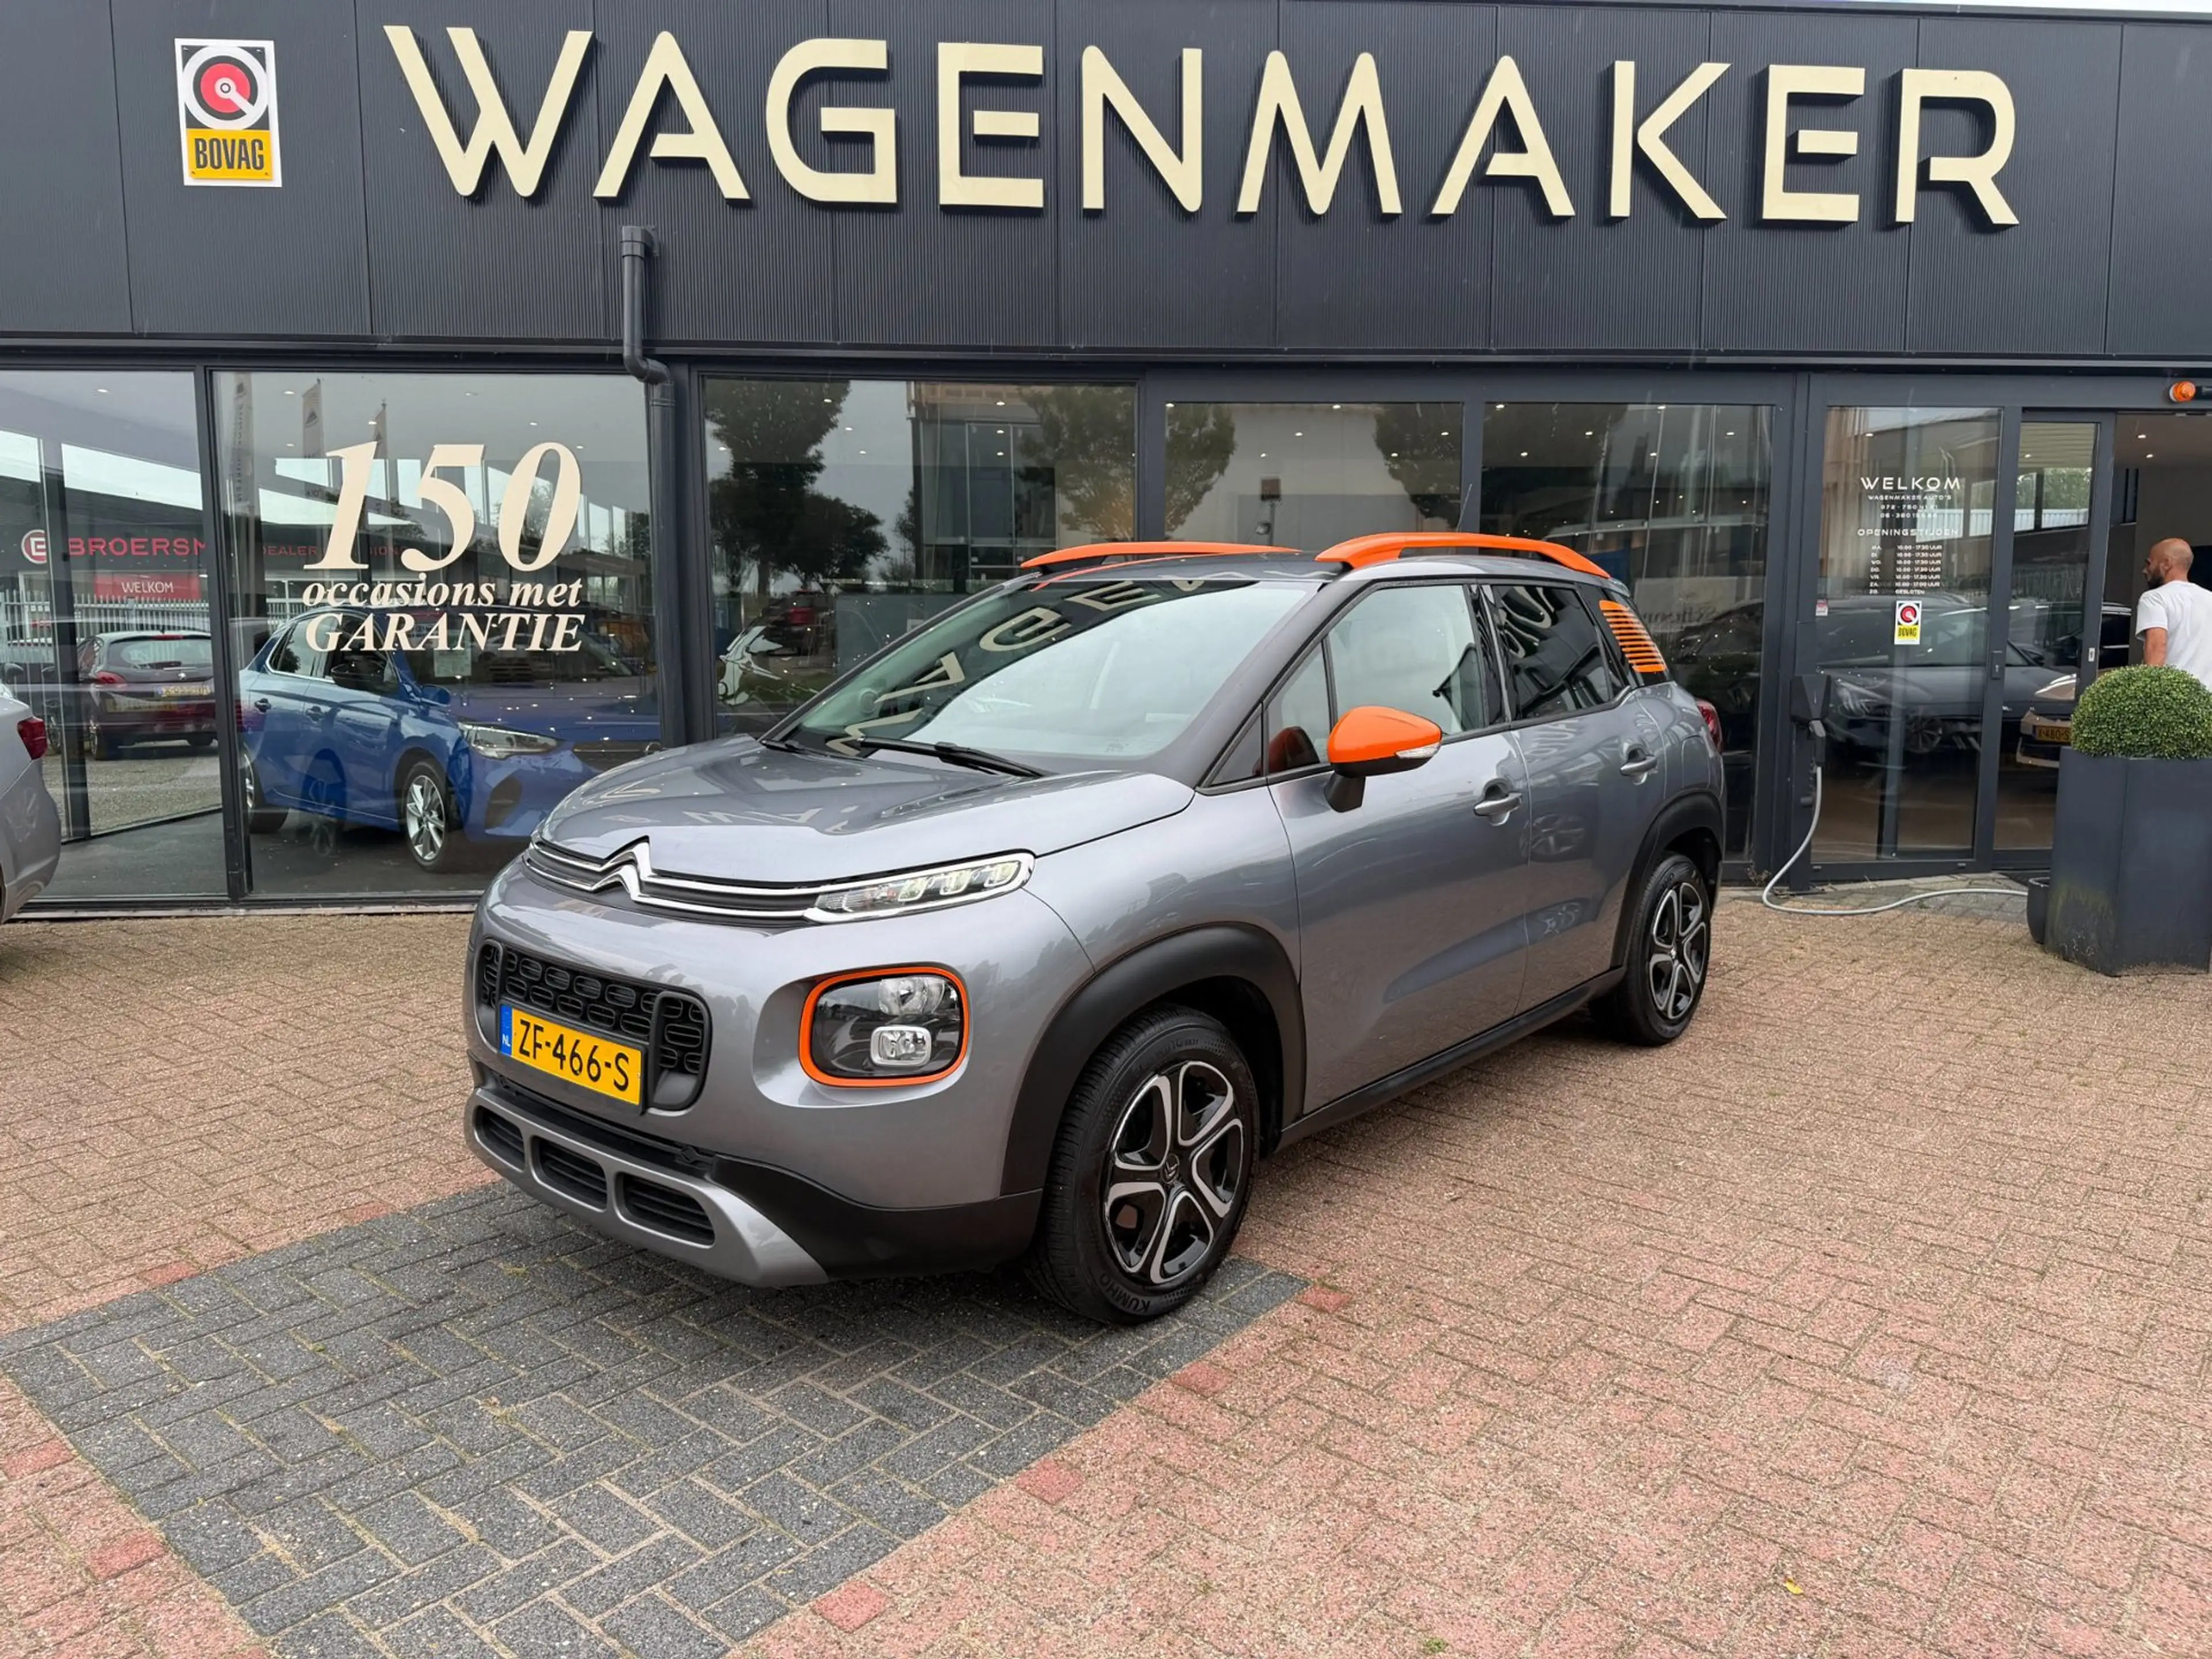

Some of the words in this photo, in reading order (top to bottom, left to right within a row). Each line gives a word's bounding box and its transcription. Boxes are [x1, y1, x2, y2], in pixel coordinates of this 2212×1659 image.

[382, 25, 2019, 227] WAGENMAKER
[195, 138, 265, 171] BOVAG
[1861, 477, 1960, 490] WELKOM
[303, 440, 582, 572] 150
[1857, 528, 1959, 537] OPENINGSTIJDEN
[263, 546, 316, 556] EALER
[122, 582, 174, 593] WELKOM
[302, 572, 495, 608] occasions
[509, 577, 581, 608] met
[305, 612, 585, 653] GARANTIE
[1899, 627, 1917, 637] BOVAG
[502, 1033, 511, 1047] NL
[518, 1018, 630, 1092] ZF-466-S
[1099, 1273, 1152, 1313] KUMHO
